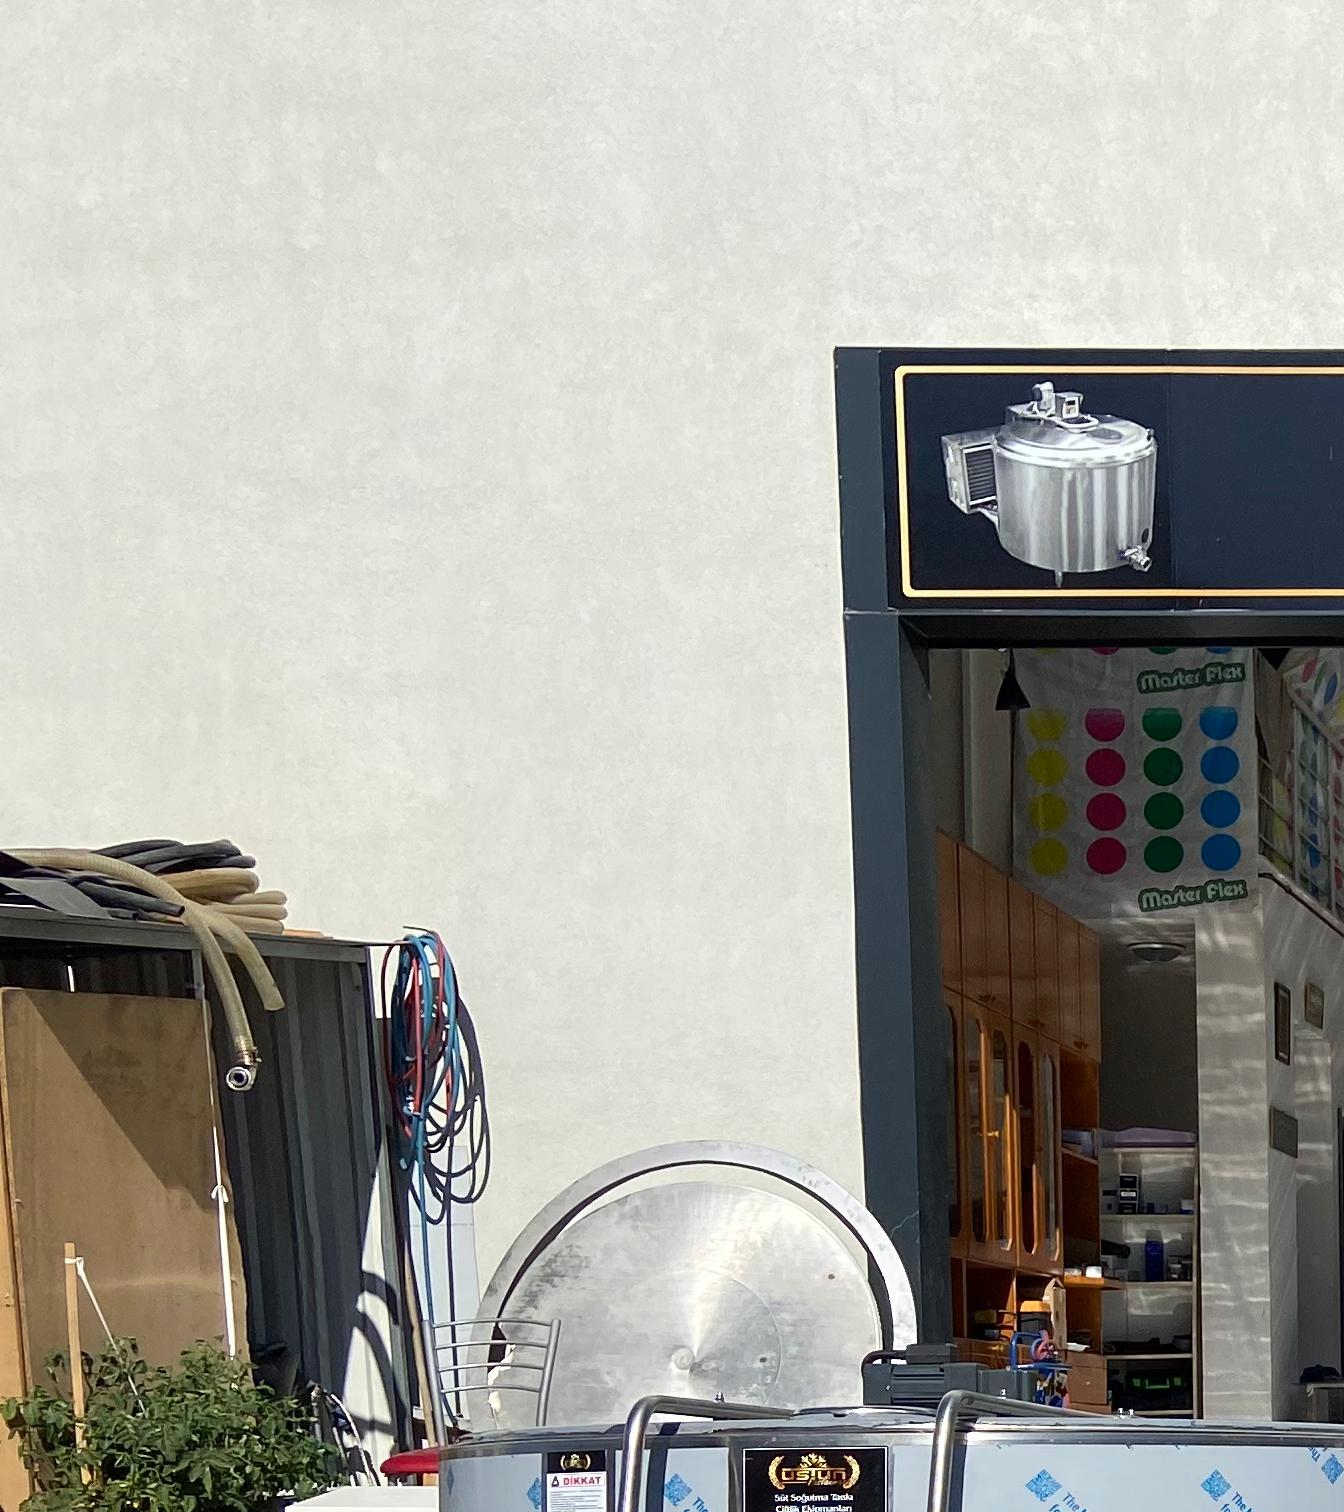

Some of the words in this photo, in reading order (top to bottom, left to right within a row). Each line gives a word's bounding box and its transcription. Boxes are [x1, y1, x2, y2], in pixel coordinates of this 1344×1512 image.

[1140, 670, 1201, 691] Master
[1205, 665, 1244, 683] Flex
[1140, 886, 1201, 909] Master
[1206, 881, 1245, 899] Flex
[563, 1475, 601, 1485] DİKKAT
[1062, 1492, 1079, 1512] The
[1232, 1492, 1246, 1511] The
